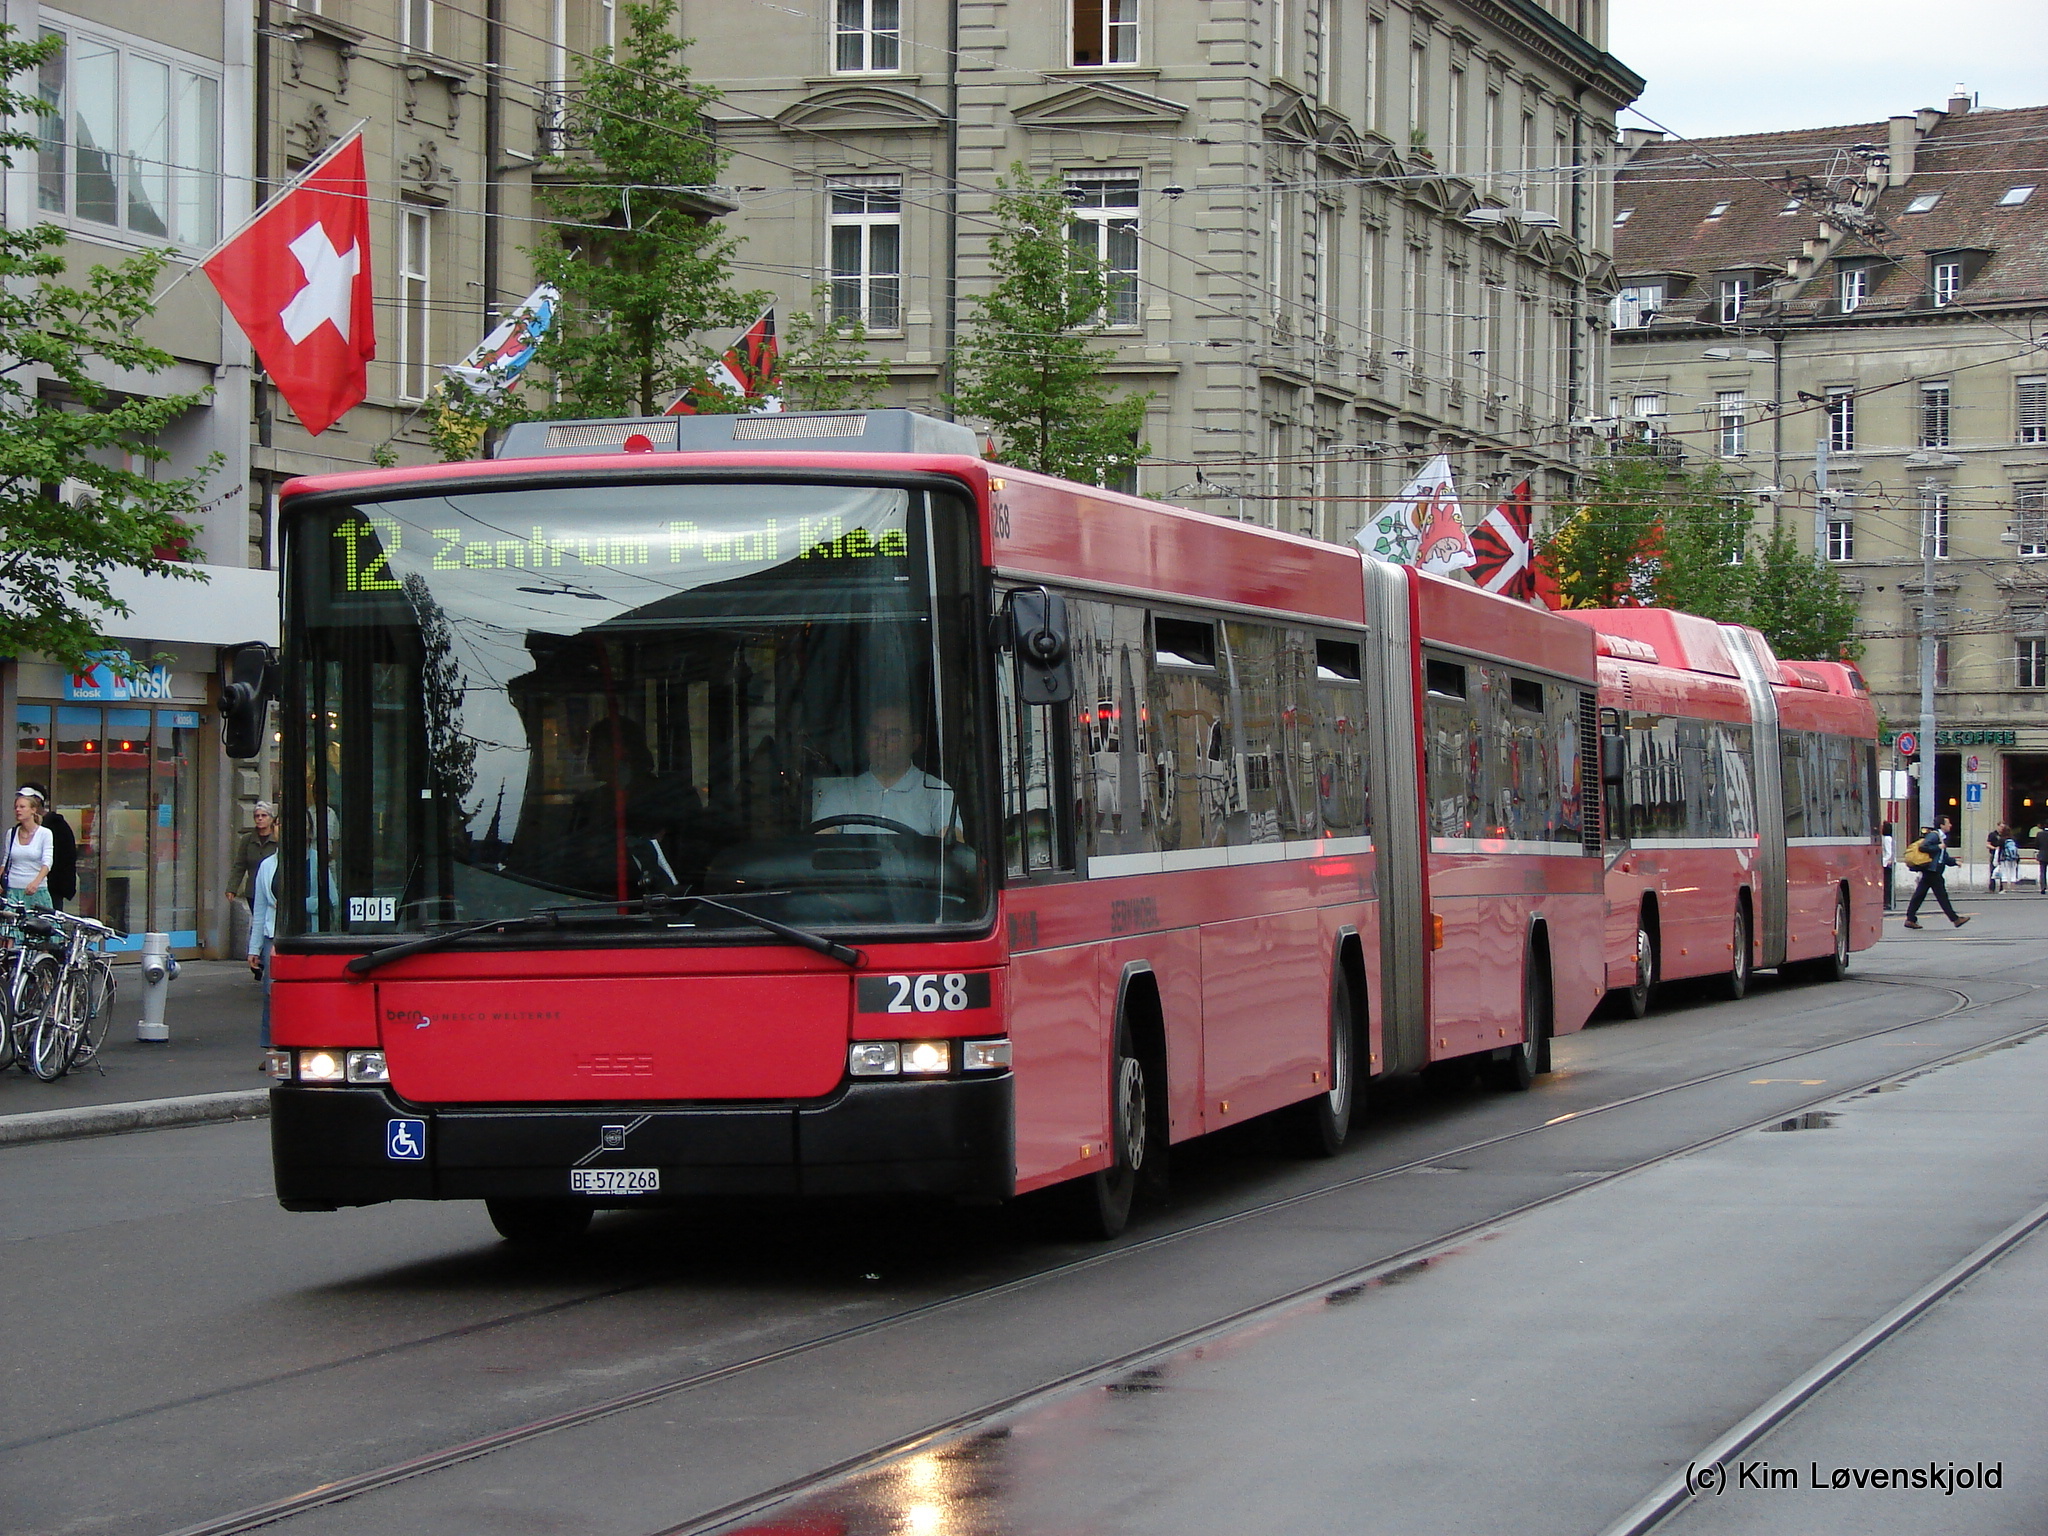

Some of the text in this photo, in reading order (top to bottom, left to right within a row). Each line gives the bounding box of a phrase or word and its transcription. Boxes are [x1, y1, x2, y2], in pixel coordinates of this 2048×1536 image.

[332, 516, 908, 590] 12 Zentrum Paul Klee
[73, 688, 101, 697] kiosk
[1952, 731, 2016, 745] COFFEE
[886, 973, 968, 1013] 268
[387, 1009, 561, 1021] bern UNESCO WELTERBE
